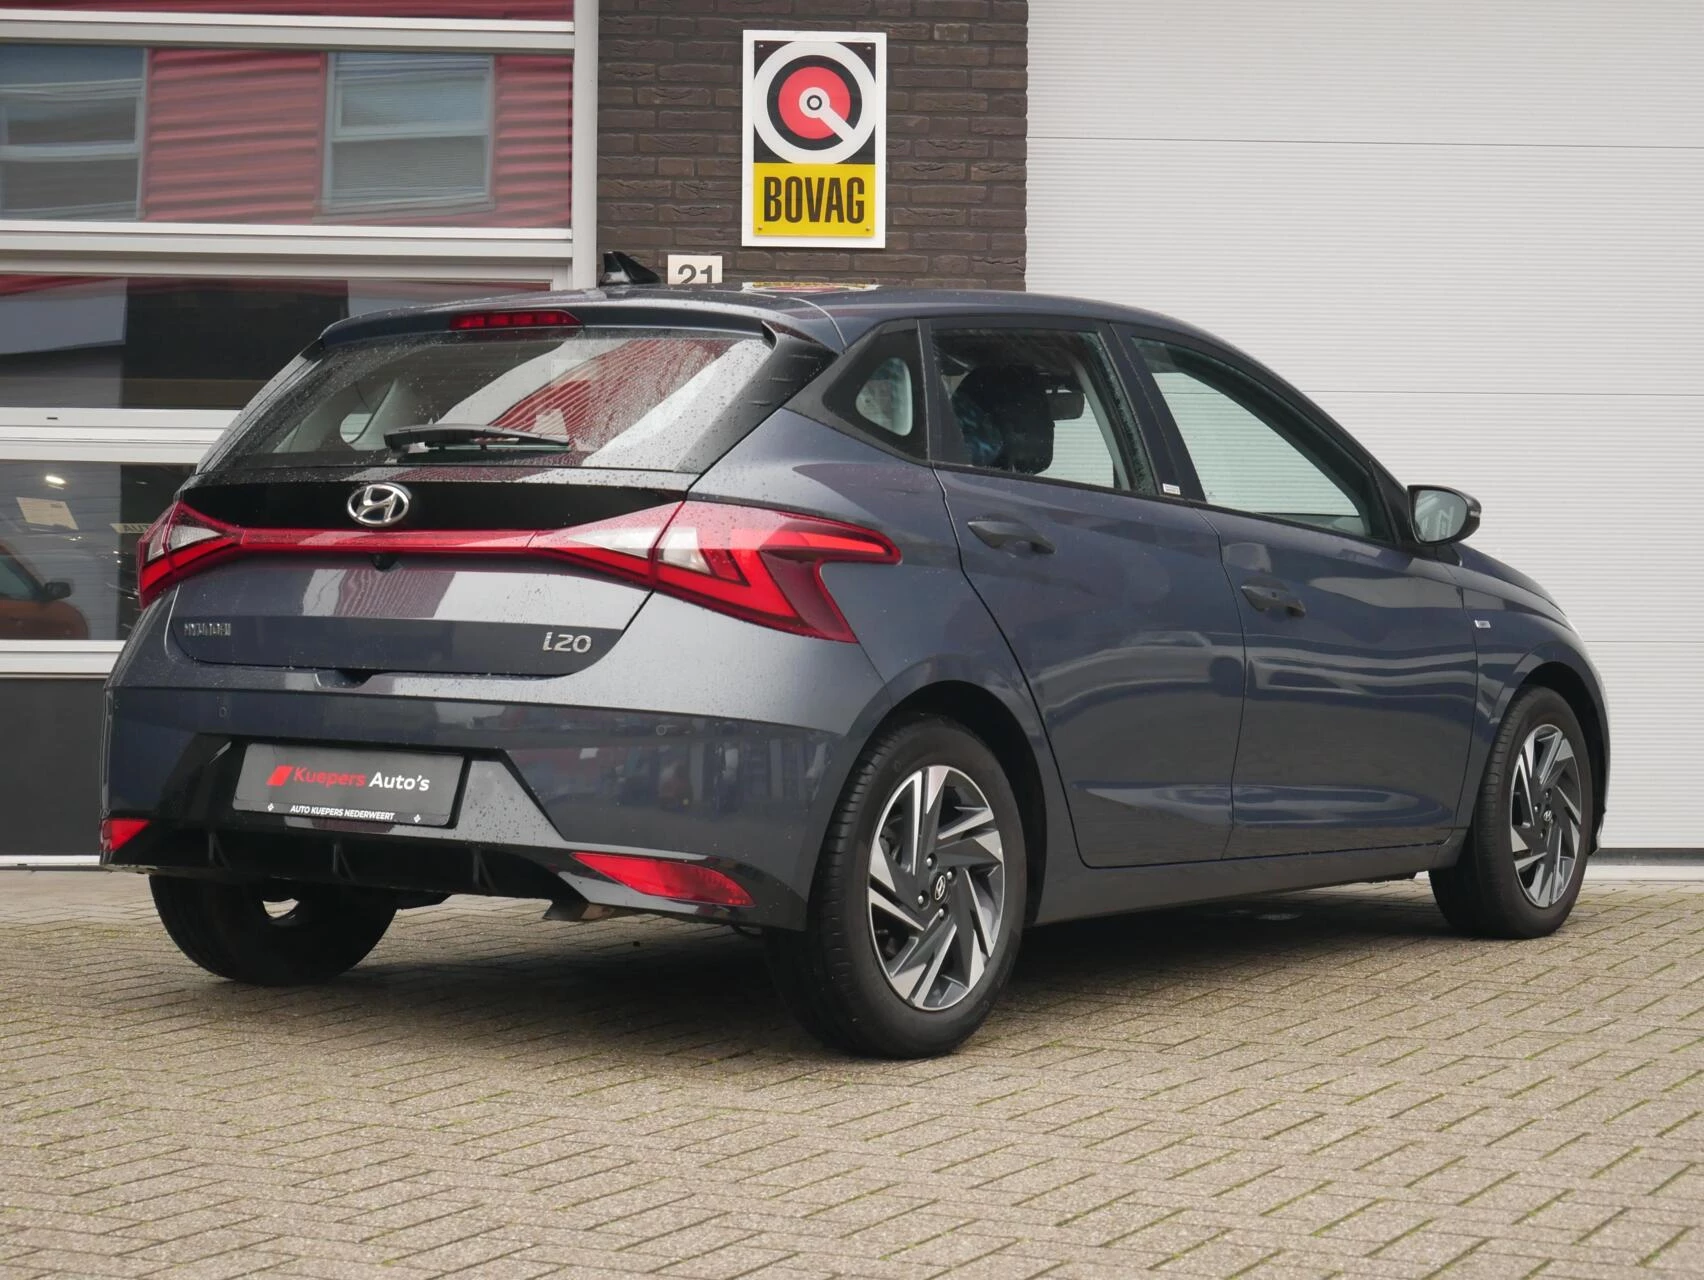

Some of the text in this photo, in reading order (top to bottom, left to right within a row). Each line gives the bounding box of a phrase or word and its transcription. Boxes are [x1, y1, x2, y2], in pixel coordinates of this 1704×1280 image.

[763, 176, 865, 224] BOVAG
[677, 264, 713, 284] 21
[542, 631, 592, 653] i20
[294, 767, 431, 792] Kuepers Auto's
[290, 804, 395, 821] AUTO KUEPERS NEDERWEERT
